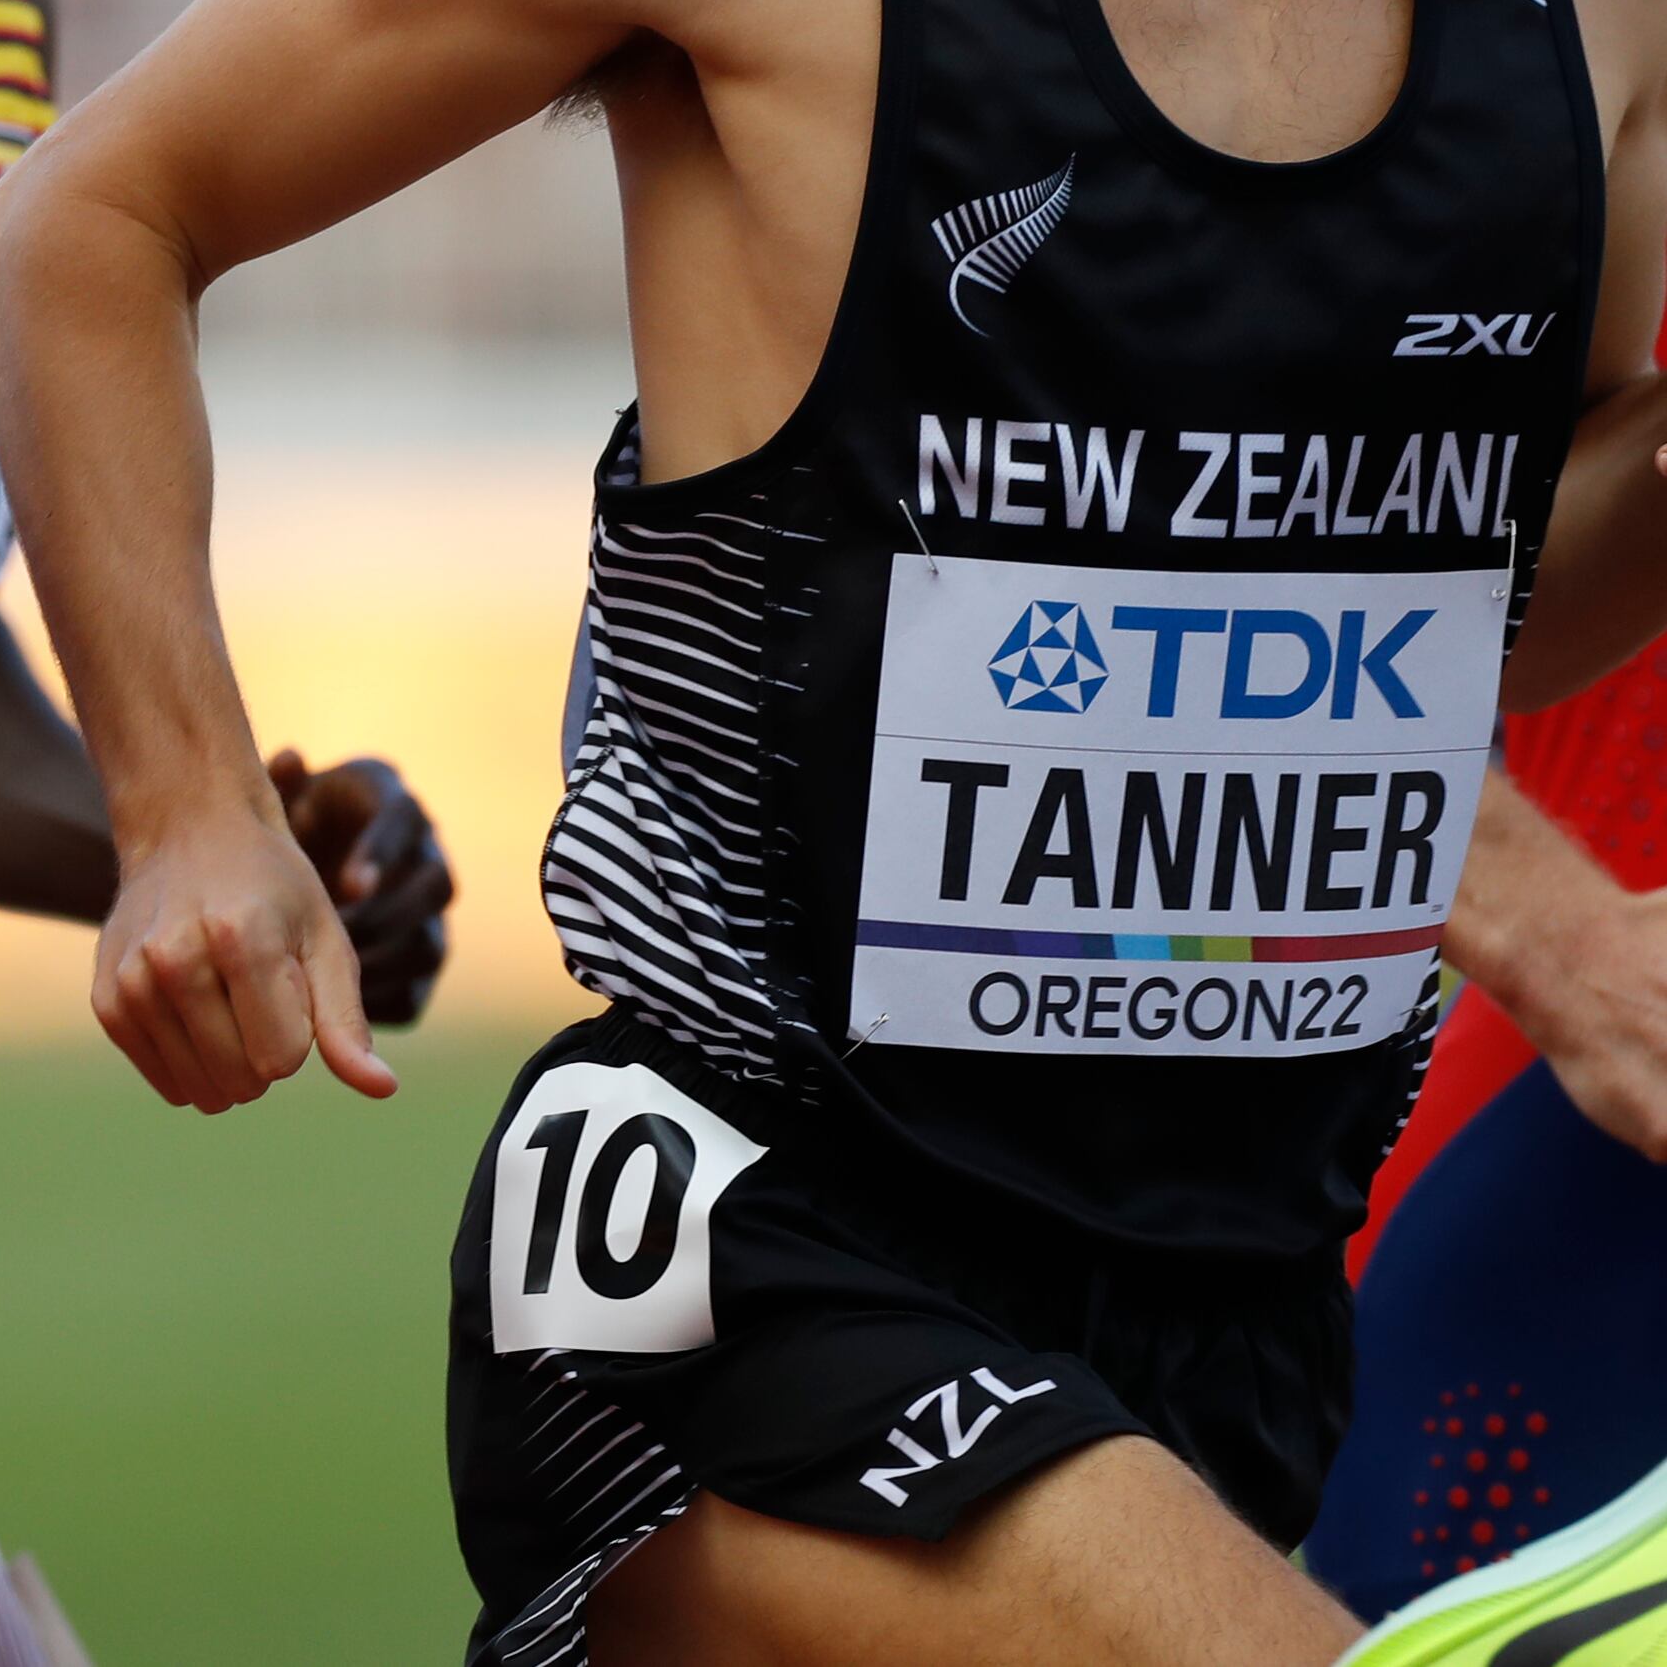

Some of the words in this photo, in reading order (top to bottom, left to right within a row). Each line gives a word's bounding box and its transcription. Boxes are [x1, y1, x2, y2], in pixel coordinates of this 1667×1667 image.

[1392, 312, 1557, 356] 2XU
[918, 413, 1146, 533] NEW
[1111, 605, 1439, 720] TDK
[920, 758, 1447, 913] TANNER
[968, 969, 1370, 1042] OREGON22
[521, 1108, 697, 1301] 10
[858, 1366, 1058, 1508] NZL
